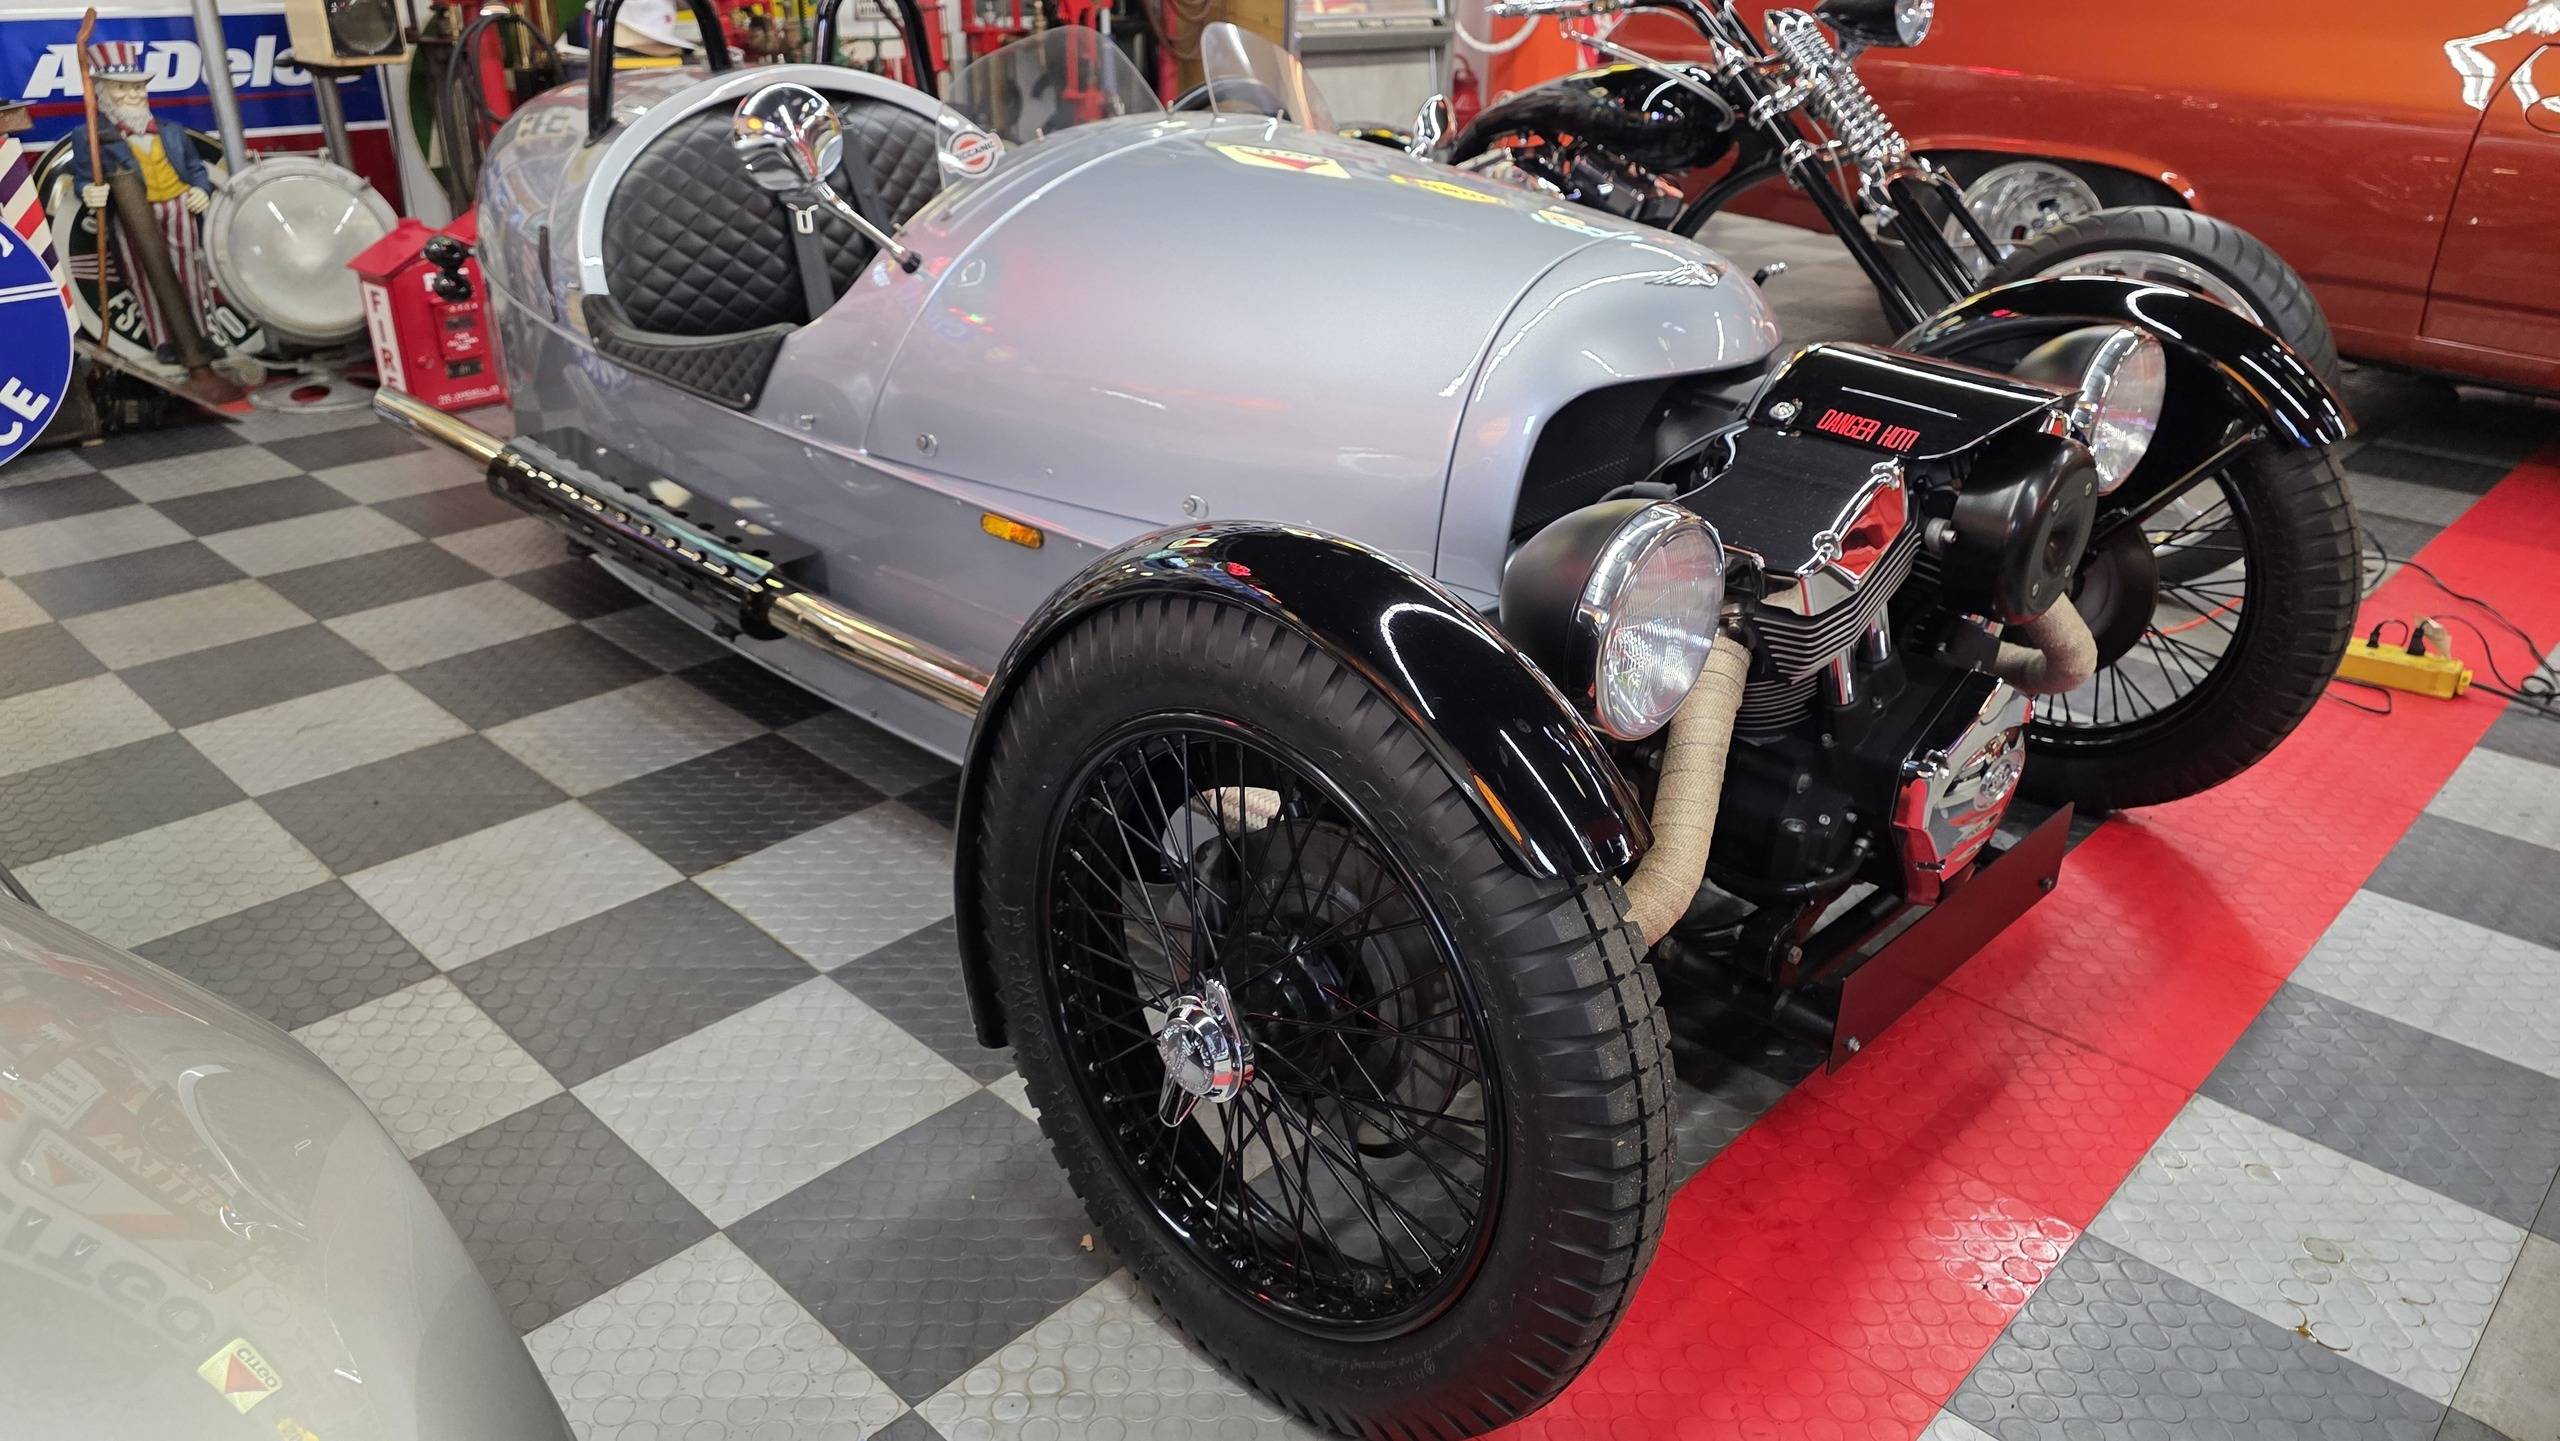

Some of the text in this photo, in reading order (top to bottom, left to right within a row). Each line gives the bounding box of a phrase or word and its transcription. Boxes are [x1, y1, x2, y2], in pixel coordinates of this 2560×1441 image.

[22, 35, 362, 98] ADelc
[1816, 408, 1920, 452] DANGER HOT!
